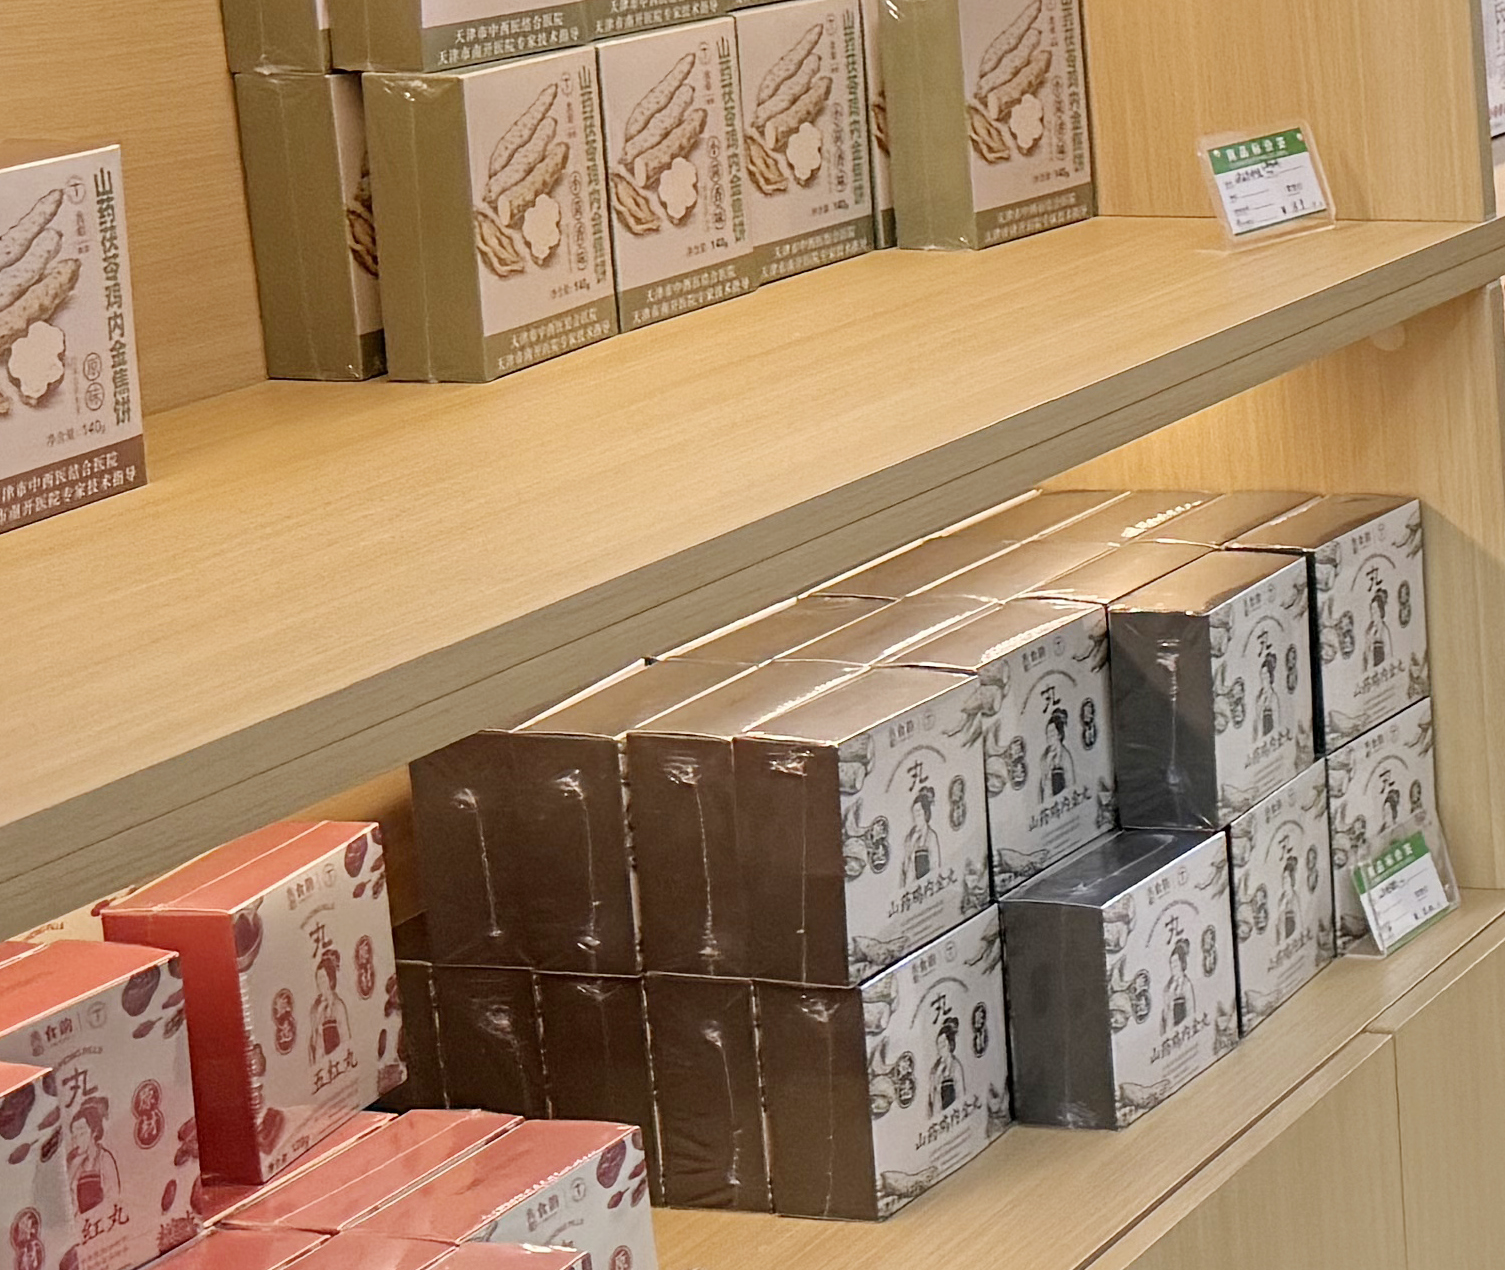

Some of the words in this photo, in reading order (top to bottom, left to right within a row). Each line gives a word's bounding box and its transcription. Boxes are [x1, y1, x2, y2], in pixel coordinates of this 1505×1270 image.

[1366, 565, 1383, 592] 丸
[1041, 686, 1061, 714] 丸
[907, 760, 929, 792] 丸
[309, 922, 332, 958] 丸
[1165, 915, 1184, 945] 丸
[931, 993, 952, 1024] 丸
[62, 1068, 97, 1108] 丸
[312, 1051, 357, 1095] 五红丸
[80, 1204, 129, 1244] 红丸
